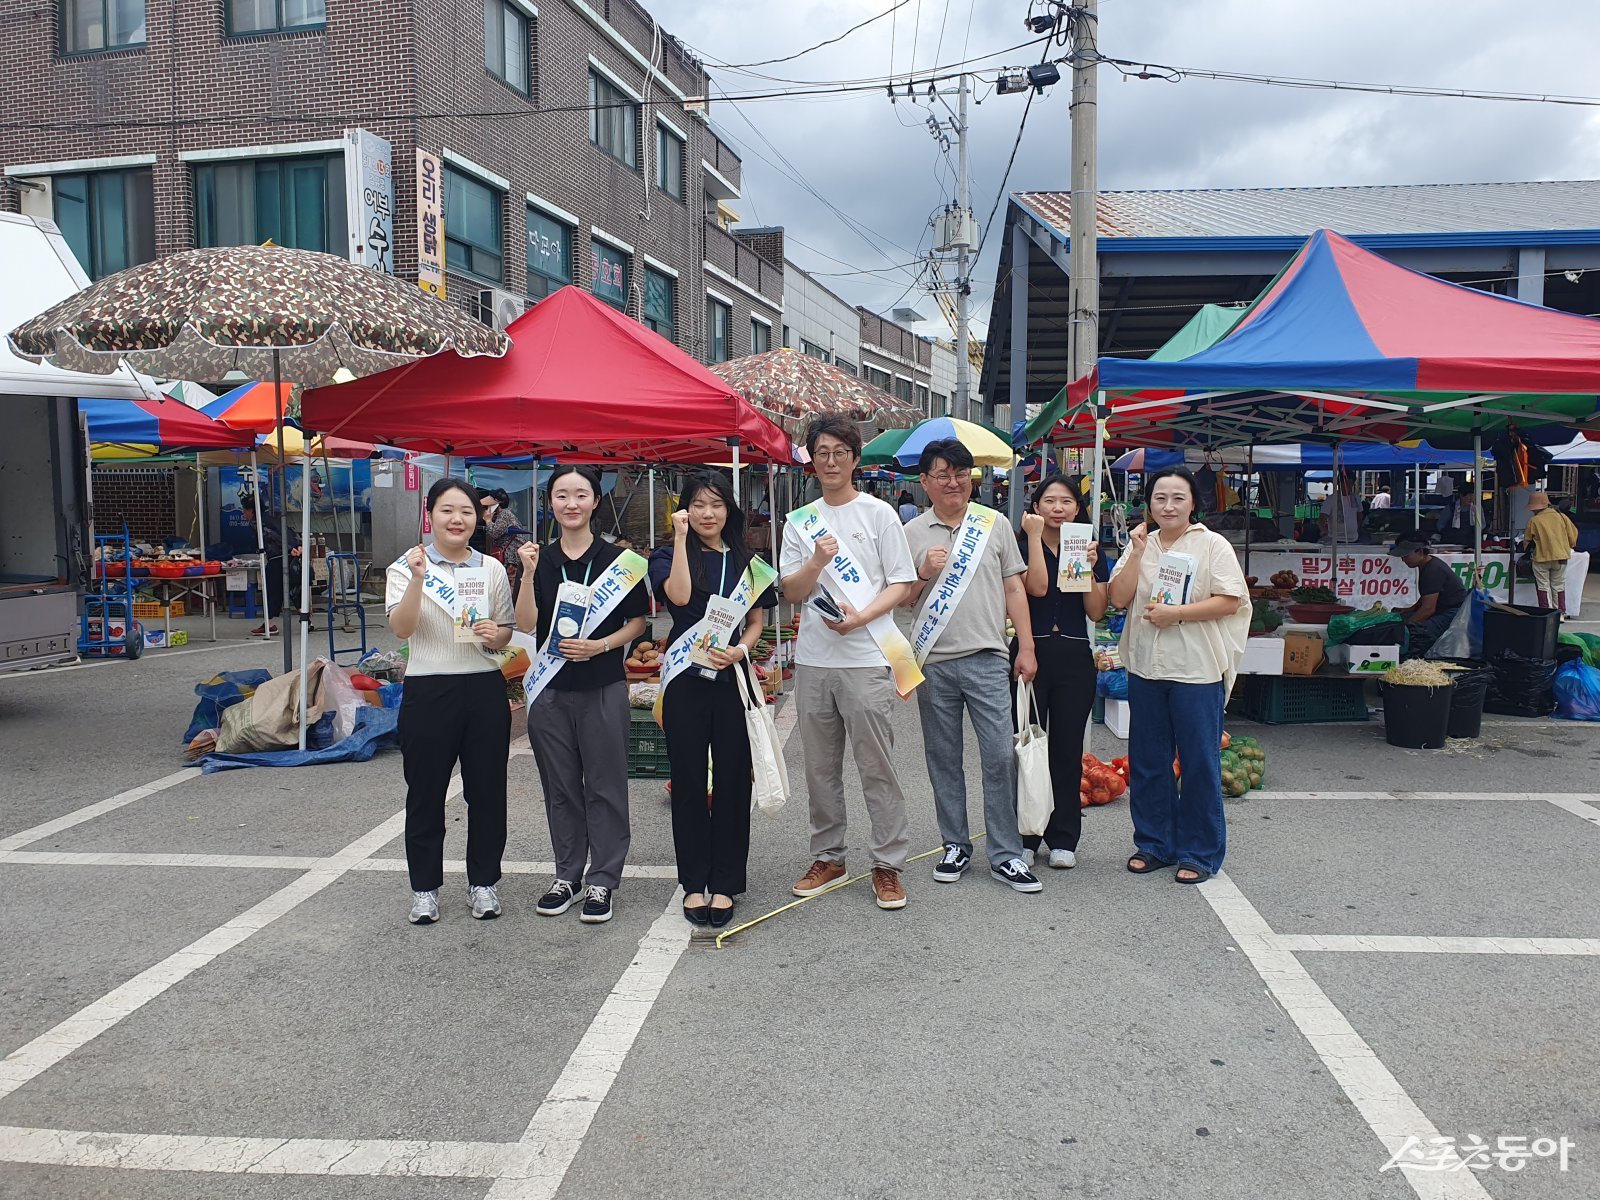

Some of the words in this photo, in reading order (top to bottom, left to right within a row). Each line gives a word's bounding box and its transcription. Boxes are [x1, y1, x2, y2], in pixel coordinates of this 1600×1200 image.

[364, 187, 391, 221] 어부
[928, 526, 984, 616] 한국농어촌공사
[1361, 558, 1392, 574] 0%
[1360, 578, 1409, 596] 100%
